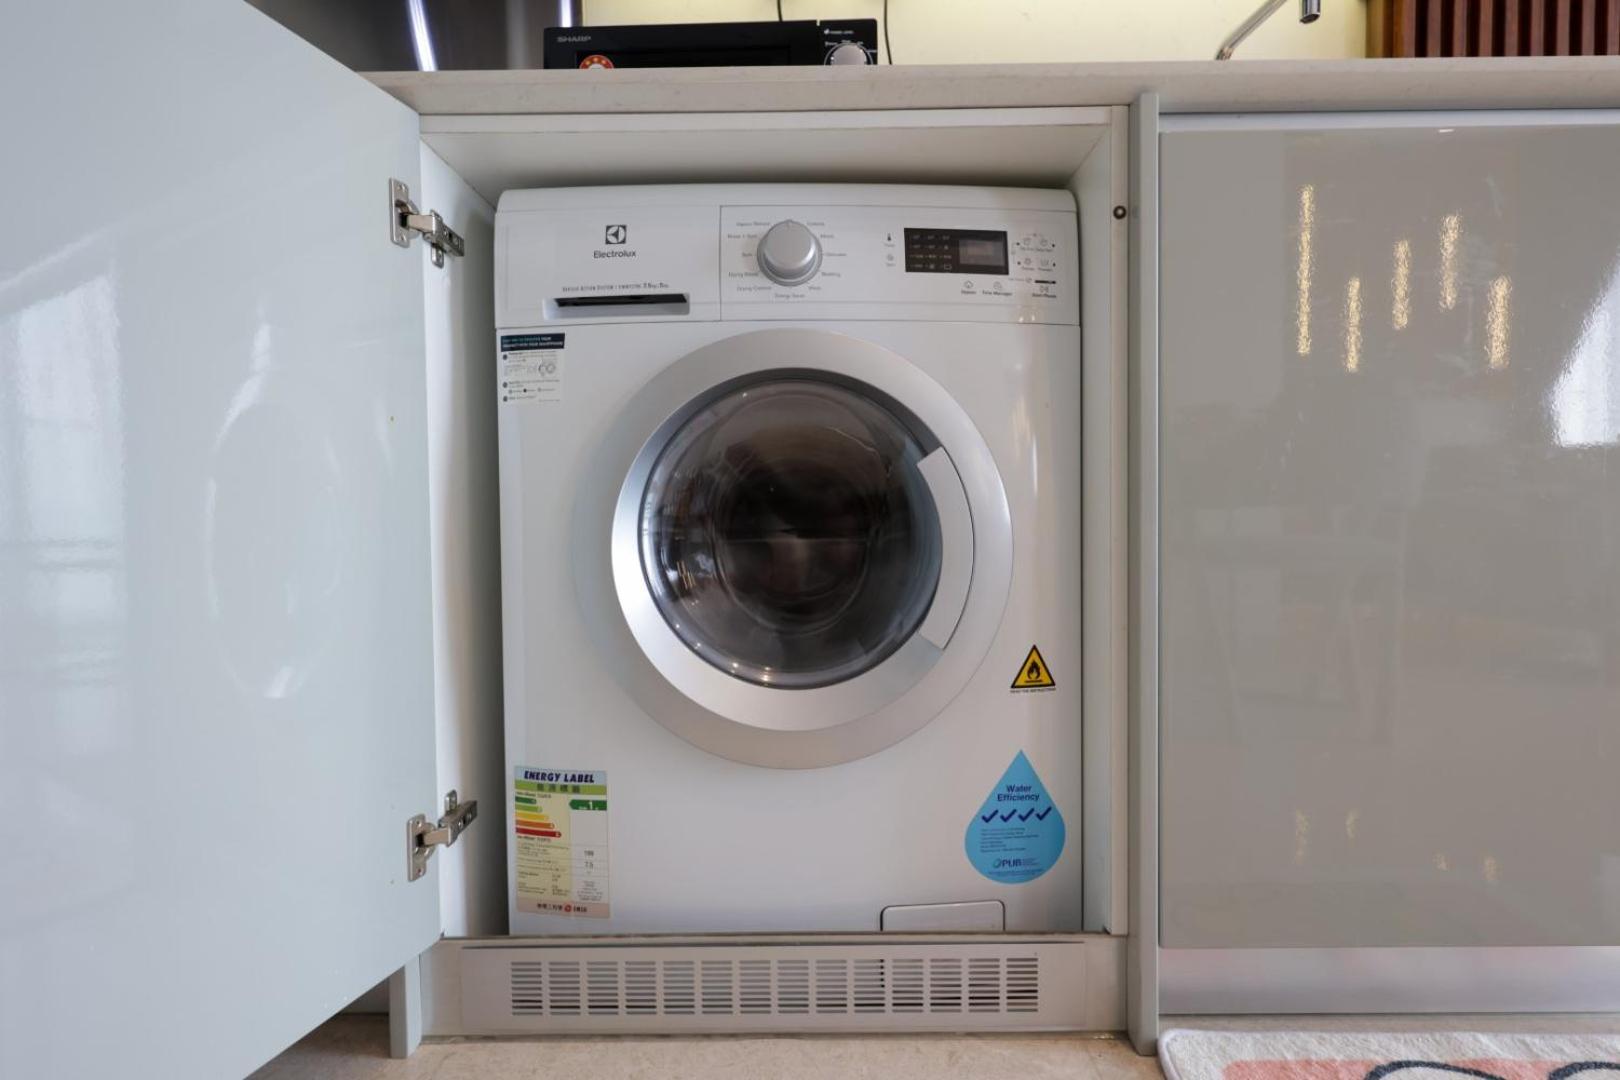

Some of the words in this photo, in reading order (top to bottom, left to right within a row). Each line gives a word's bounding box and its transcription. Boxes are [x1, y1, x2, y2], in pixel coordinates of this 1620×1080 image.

[557, 35, 592, 43] SHARP
[593, 250, 637, 259] Electrolux
[524, 770, 561, 782] ENERGY
[564, 773, 595, 783] LABEL
[1006, 784, 1032, 793] Water
[997, 793, 1040, 802] Efficiency
[1002, 858, 1022, 868] PUB
